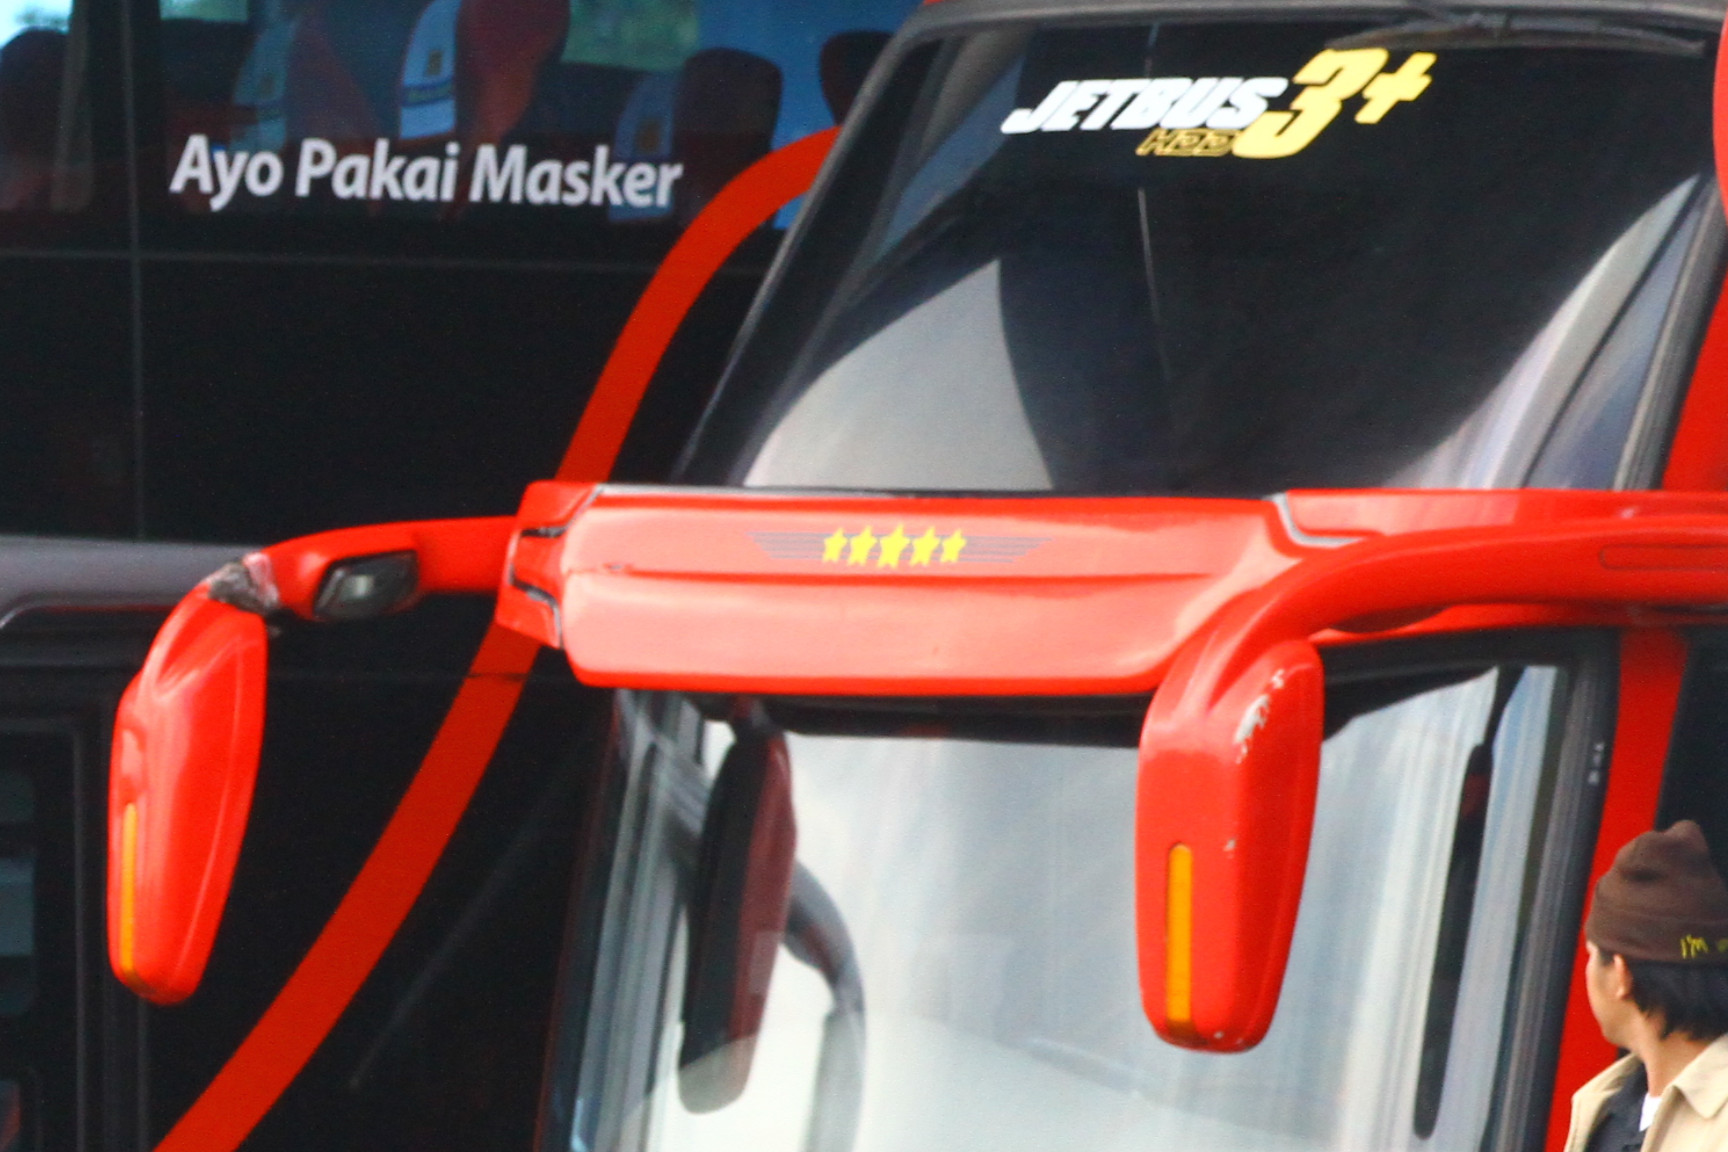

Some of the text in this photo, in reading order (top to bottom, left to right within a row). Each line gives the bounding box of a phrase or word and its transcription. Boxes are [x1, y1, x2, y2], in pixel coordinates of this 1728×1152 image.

[1000, 76, 1290, 134] JETBUS
[169, 133, 683, 212] Ayo Pakai Masker
